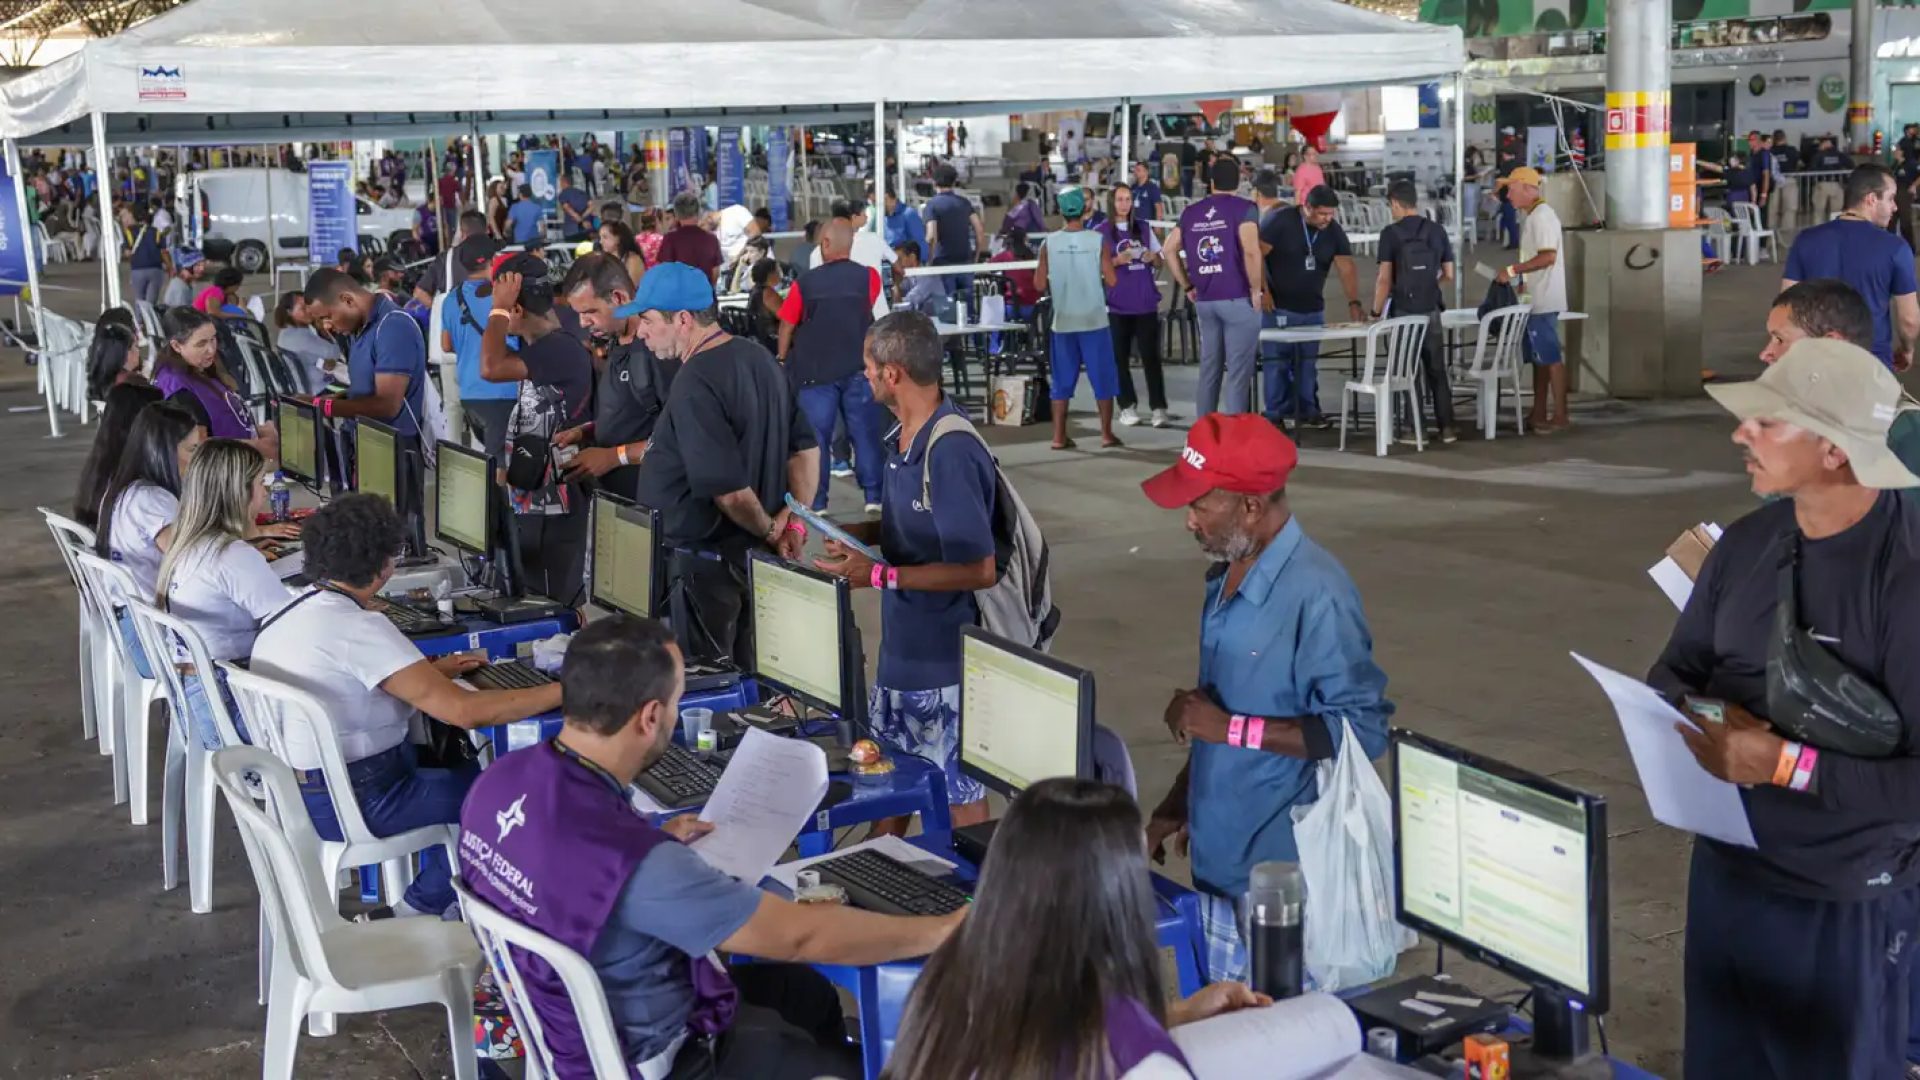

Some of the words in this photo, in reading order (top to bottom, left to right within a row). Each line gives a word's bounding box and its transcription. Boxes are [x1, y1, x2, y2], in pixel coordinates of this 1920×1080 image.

[1182, 446, 1207, 470] niz
[462, 830, 493, 860] JUSTIÇA
[492, 853, 534, 899] FEDERAL
